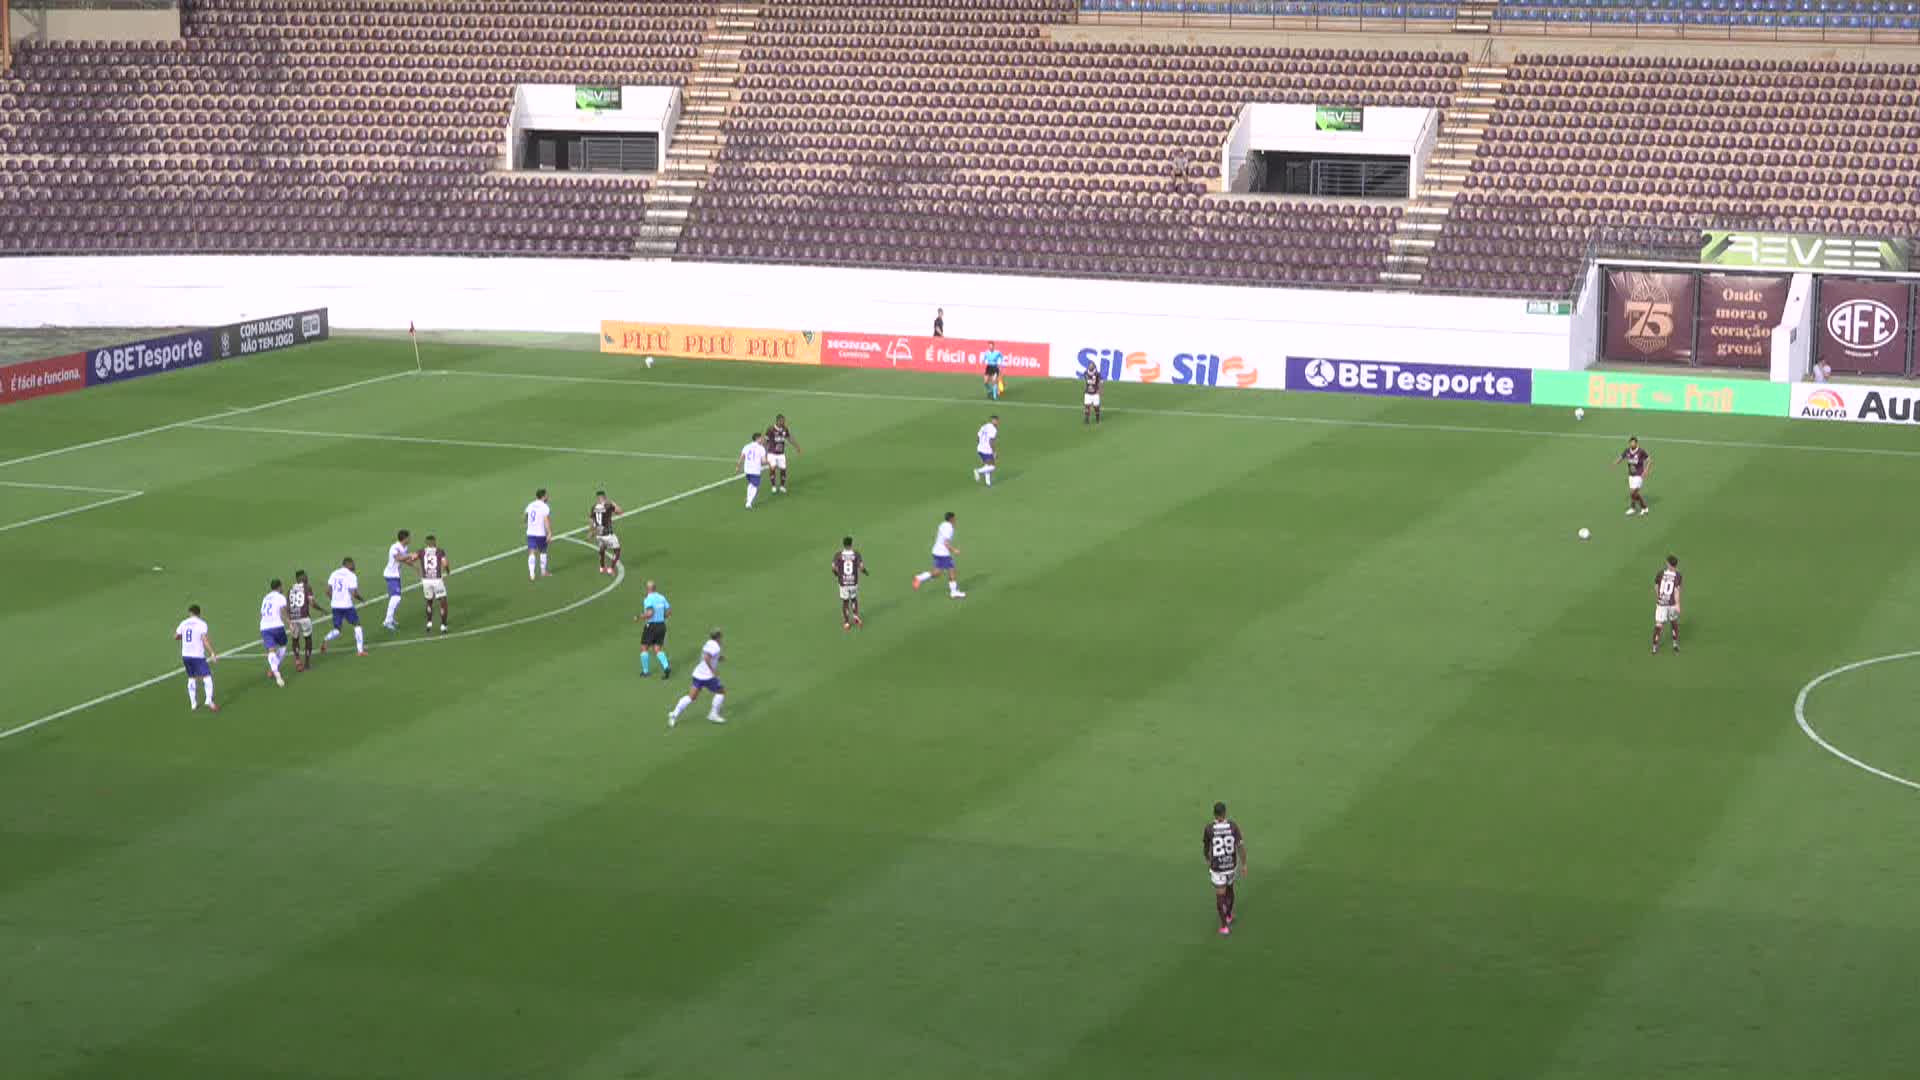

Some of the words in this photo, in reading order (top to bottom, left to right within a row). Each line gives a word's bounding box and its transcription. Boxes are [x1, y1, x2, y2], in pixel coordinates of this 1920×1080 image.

[1722, 288, 1763, 302] Onde
[1624, 301, 1673, 337] 75
[1715, 308, 1756, 320] mora
[1757, 310, 1768, 320] o
[1831, 305, 1890, 343] AFE
[240, 324, 258, 338] COM
[259, 316, 294, 334] RACISMO
[1711, 325, 1771, 340] coração
[241, 340, 258, 353] NÃO
[259, 338, 274, 350] TEM
[275, 333, 294, 347] JOGO
[827, 339, 881, 352] HONDA
[1717, 342, 1763, 356] grená
[113, 338, 203, 374] BETesporte
[925, 344, 934, 361] É
[937, 348, 965, 363] fácil
[968, 352, 976, 364] e
[1075, 347, 1123, 382] Sil
[1171, 352, 1220, 387] Sil
[1338, 362, 1515, 397] BETesporte
[1801, 406, 1847, 418] Aurora
[843, 560, 854, 575] 8
[1660, 579, 1675, 595] 10
[1212, 836, 1236, 857] 29
